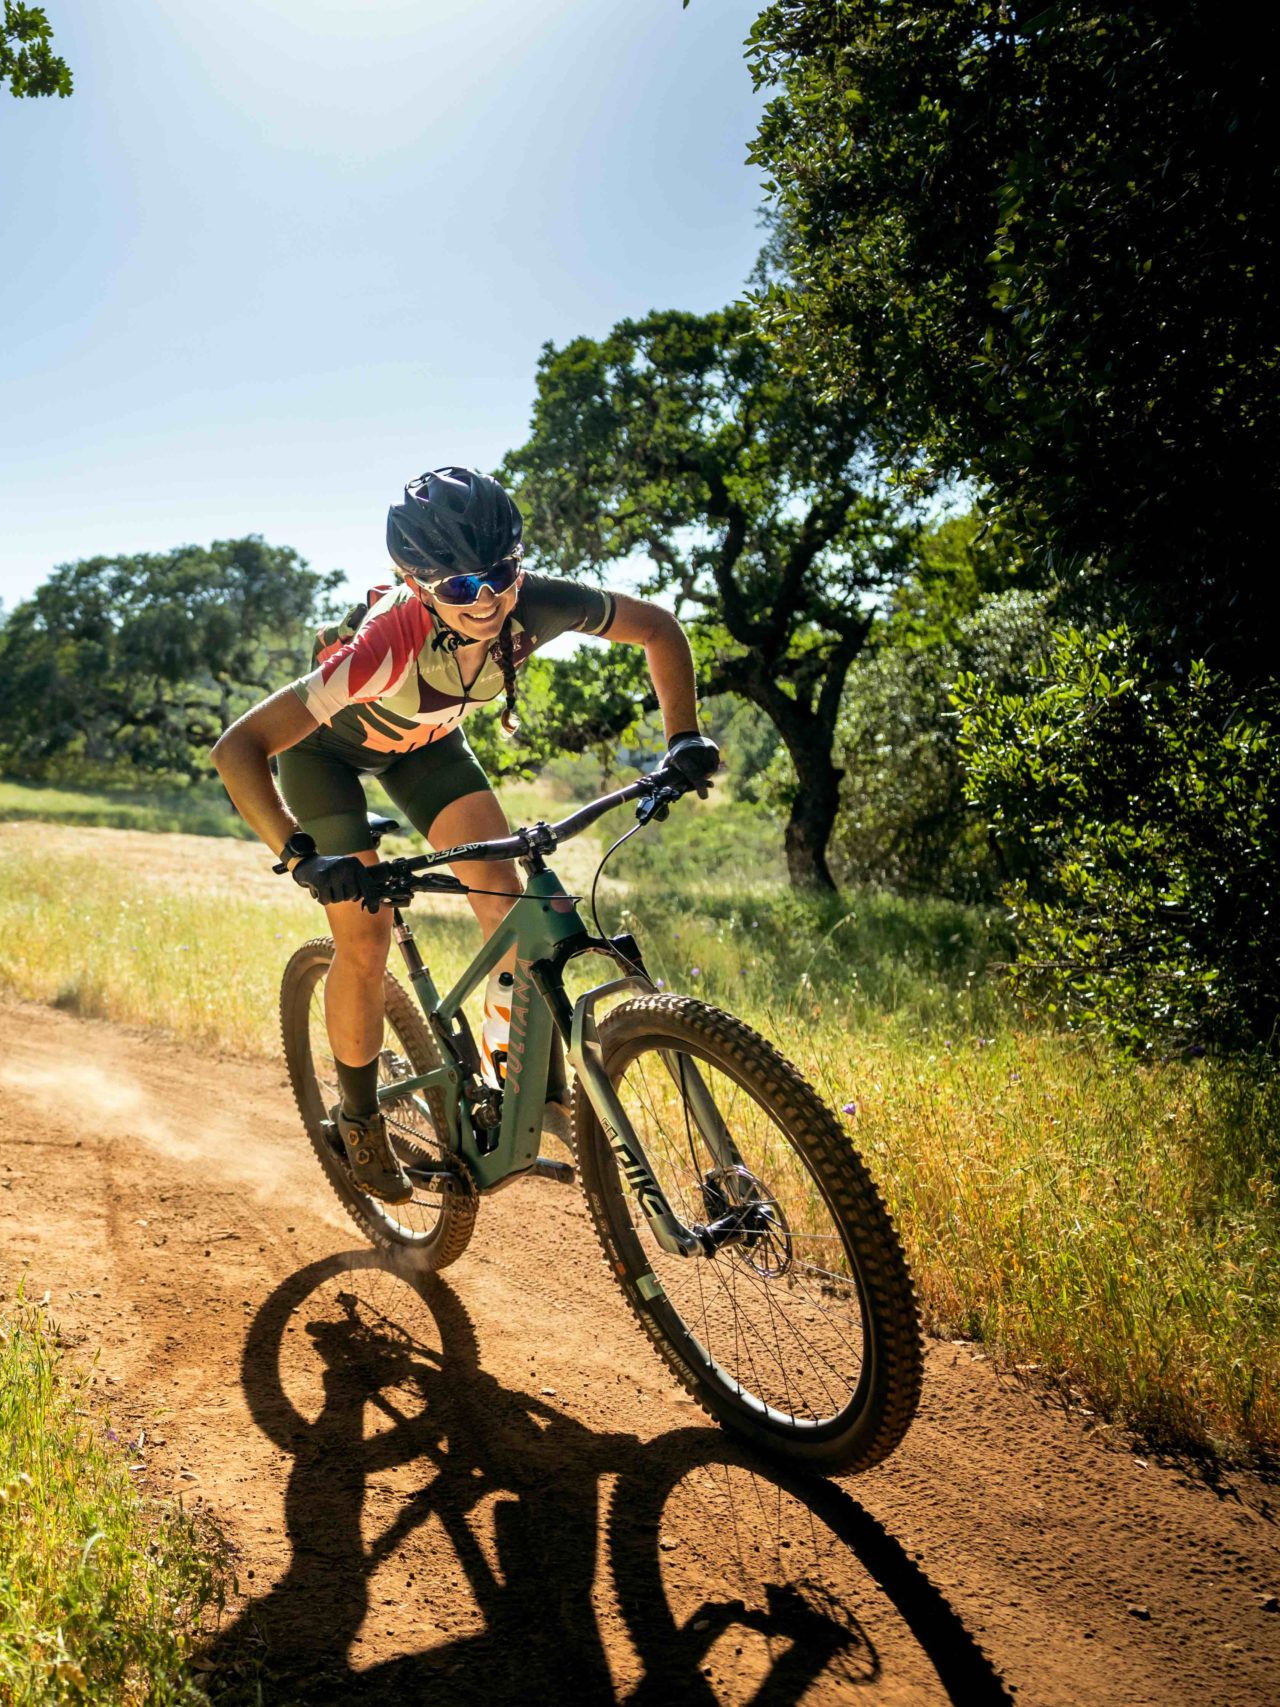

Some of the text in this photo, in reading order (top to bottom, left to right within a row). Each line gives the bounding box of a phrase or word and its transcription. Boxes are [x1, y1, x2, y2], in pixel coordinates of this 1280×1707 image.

[506, 958, 535, 1094] JULIANA
[613, 1143, 671, 1218] PIKE
[348, 1203, 392, 1249] MAXXIS
[660, 1340, 699, 1385] MINION
